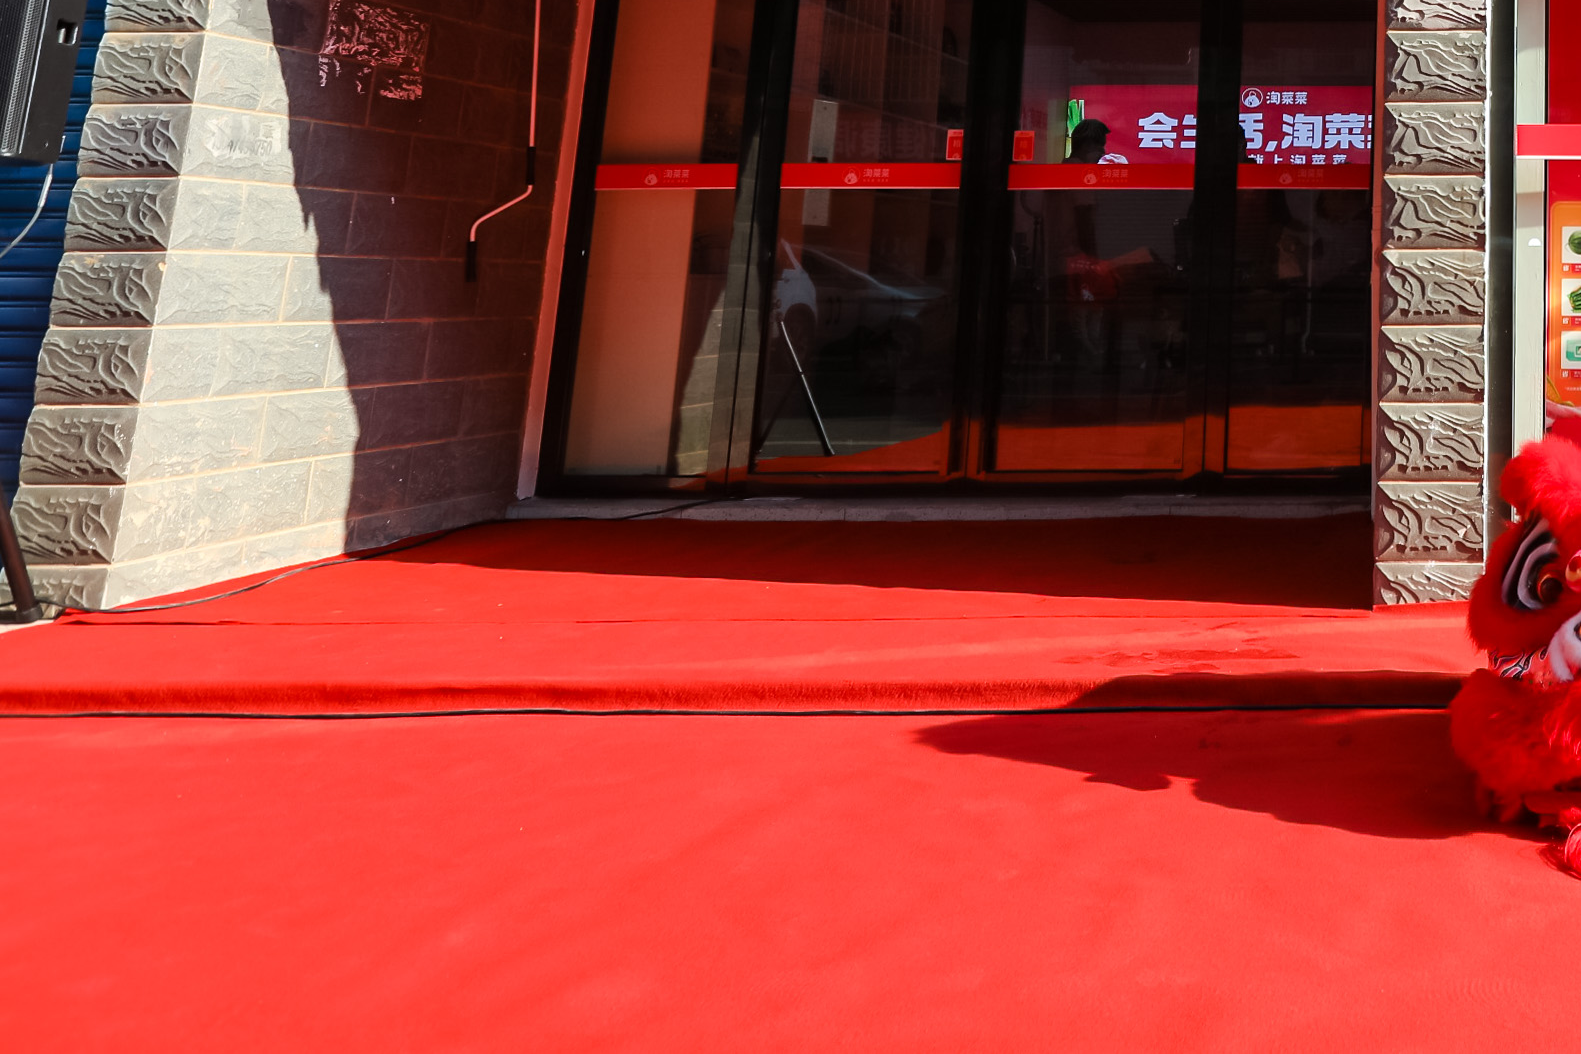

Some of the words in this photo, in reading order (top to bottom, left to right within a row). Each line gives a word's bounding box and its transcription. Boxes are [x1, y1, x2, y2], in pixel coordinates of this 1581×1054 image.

[1265, 91, 1308, 105] 淘菜菜
[863, 168, 890, 179] 淘菜菜
